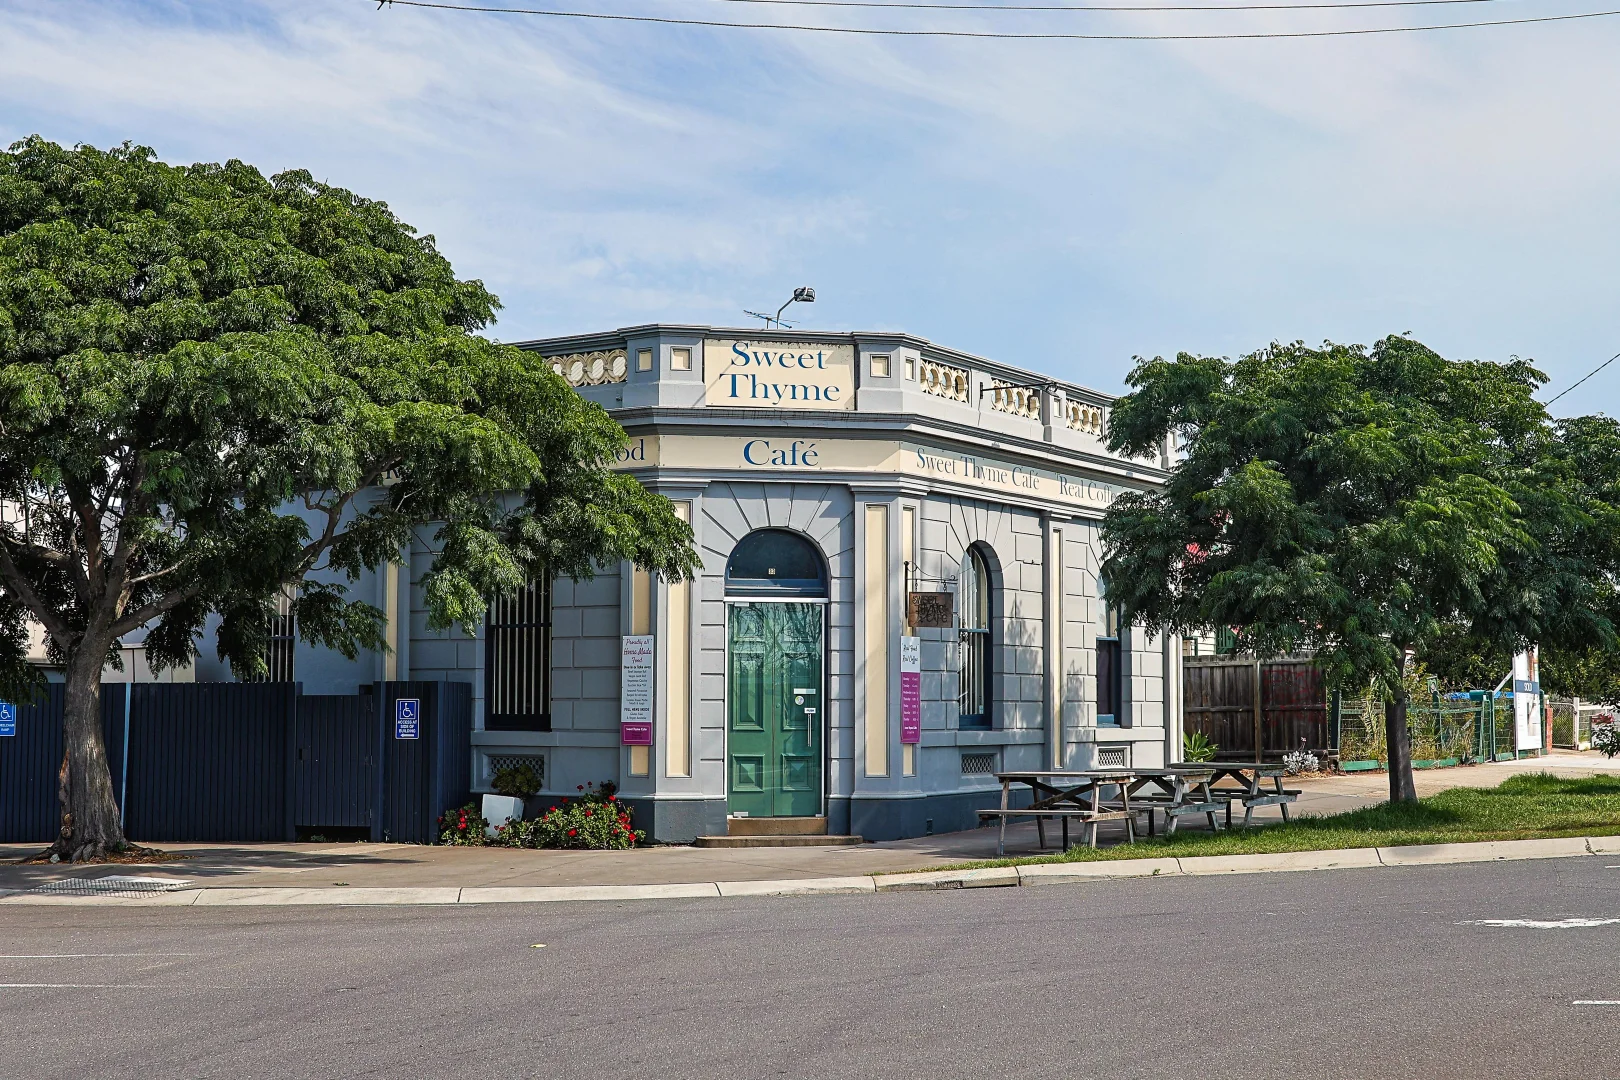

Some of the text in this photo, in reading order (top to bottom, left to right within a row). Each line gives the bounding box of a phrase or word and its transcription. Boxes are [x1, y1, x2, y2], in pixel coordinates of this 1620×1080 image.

[731, 341, 828, 370] Sweet
[718, 373, 841, 405] Thyme
[743, 439, 819, 466] Café
[916, 447, 1040, 490] Sweet Thyme Café
[1087, 481, 1117, 503] Coffe
[1523, 682, 1533, 692] SOLD
